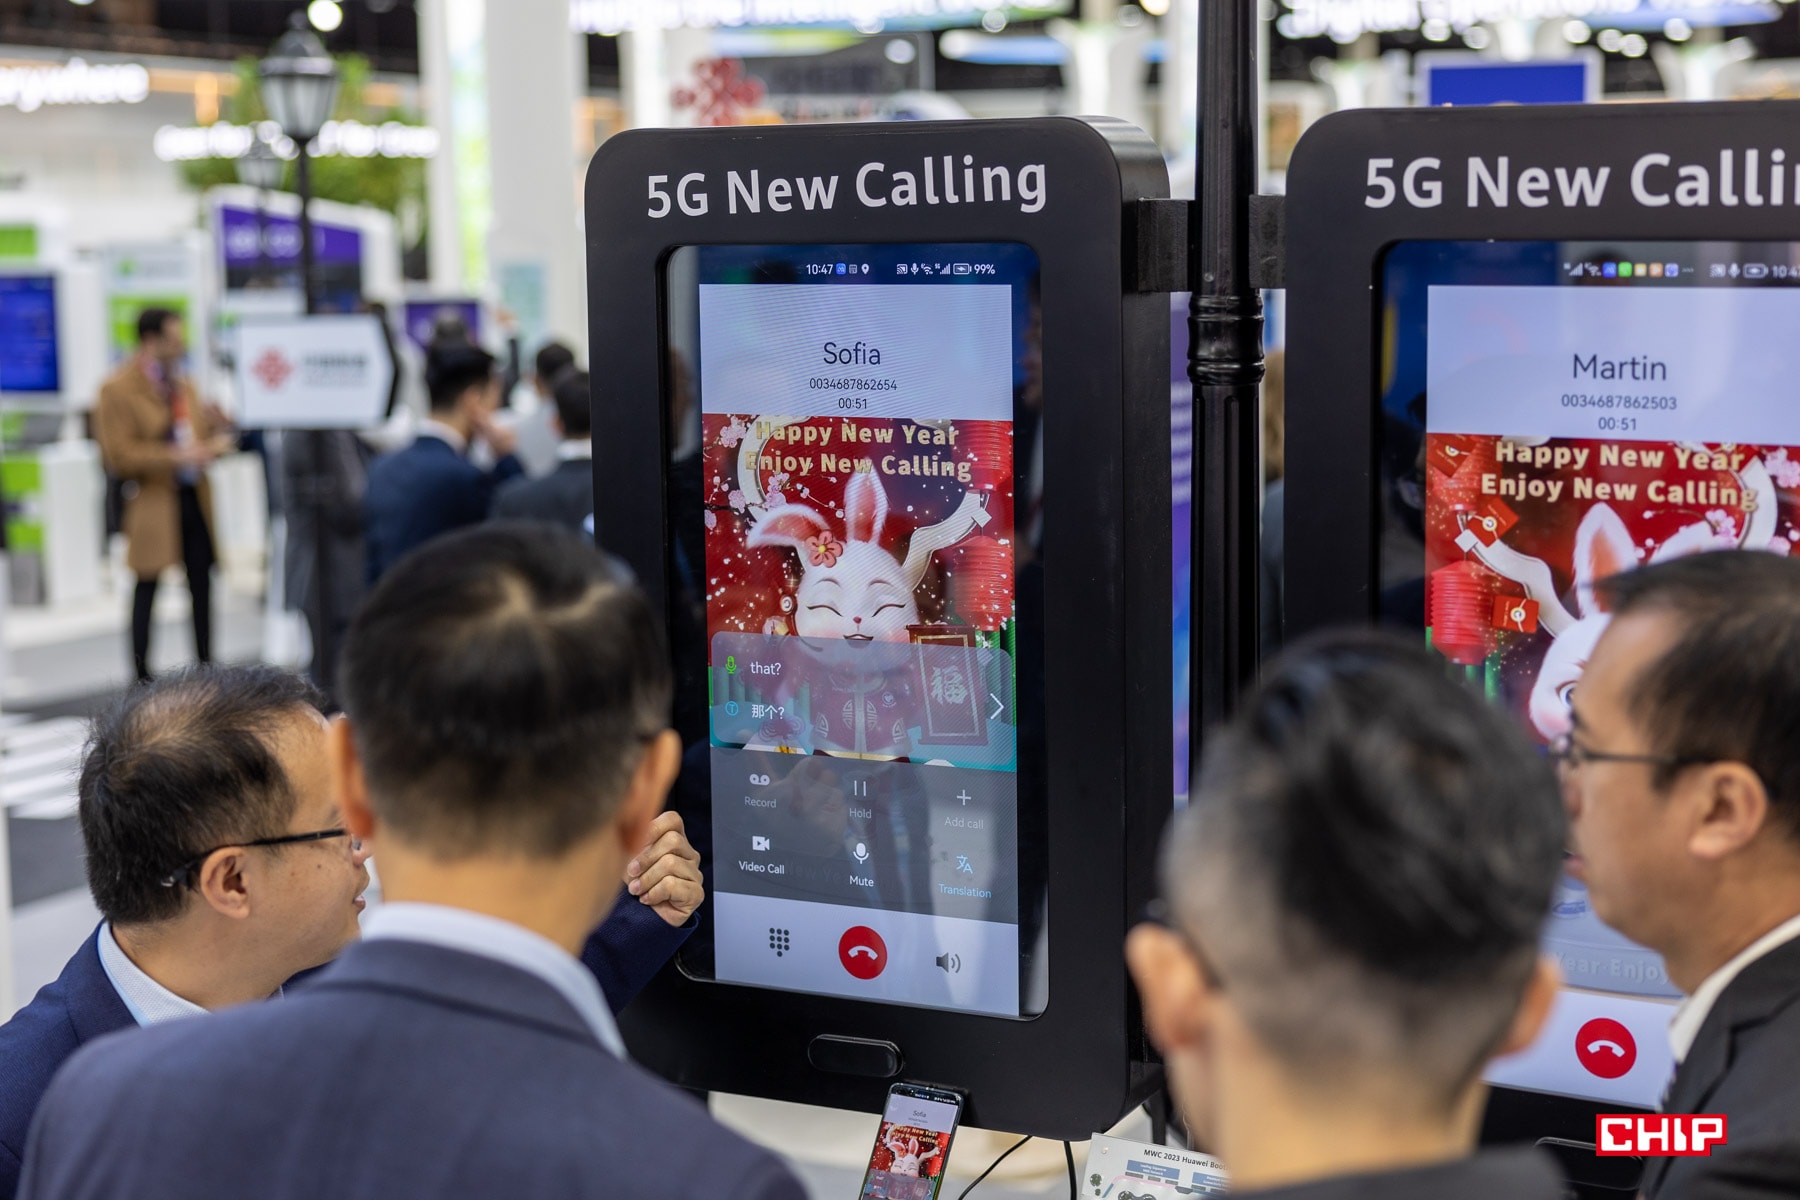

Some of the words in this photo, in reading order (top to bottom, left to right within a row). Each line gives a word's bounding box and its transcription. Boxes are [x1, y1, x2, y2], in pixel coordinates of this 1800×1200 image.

[1365, 157, 1443, 208] 5G
[1467, 156, 1611, 207] New
[1630, 148, 1800, 207] Calli
[648, 173, 708, 218] 5G
[727, 169, 839, 214] New
[856, 155, 1047, 213] Calling
[805, 263, 834, 275] 10:47
[973, 263, 996, 275] 99%
[1772, 264, 1800, 278] 10:4
[823, 341, 881, 365] Sofia
[1572, 353, 1667, 381] Martin
[809, 377, 898, 391] 0034687862654
[838, 397, 867, 410] 00:51
[1561, 393, 1678, 411] 0034687862503
[1598, 416, 1637, 431] 00:51
[756, 421, 832, 447] Happy
[841, 423, 894, 443] New
[901, 424, 960, 446] Year
[1496, 441, 1589, 470] Happy
[1599, 444, 1664, 468] New
[1673, 447, 1745, 471] Year
[745, 451, 813, 474] Enjoy
[820, 453, 873, 473] New
[881, 454, 972, 483] Calling
[1481, 473, 1563, 502] Enjoy
[1573, 477, 1637, 500] New
[1647, 480, 1758, 513] Calling
[750, 661, 782, 676] that?
[744, 796, 777, 809] Record
[849, 808, 872, 819] Hold
[944, 816, 965, 828] Add
[967, 819, 984, 830] call
[738, 860, 766, 873] Video
[767, 863, 785, 875] Call
[849, 875, 875, 887] Mute
[938, 883, 992, 899] Translation
[1143, 1149, 1163, 1159] MWC
[1163, 1153, 1181, 1162] 2023
[1181, 1156, 1209, 1168] Huawei
